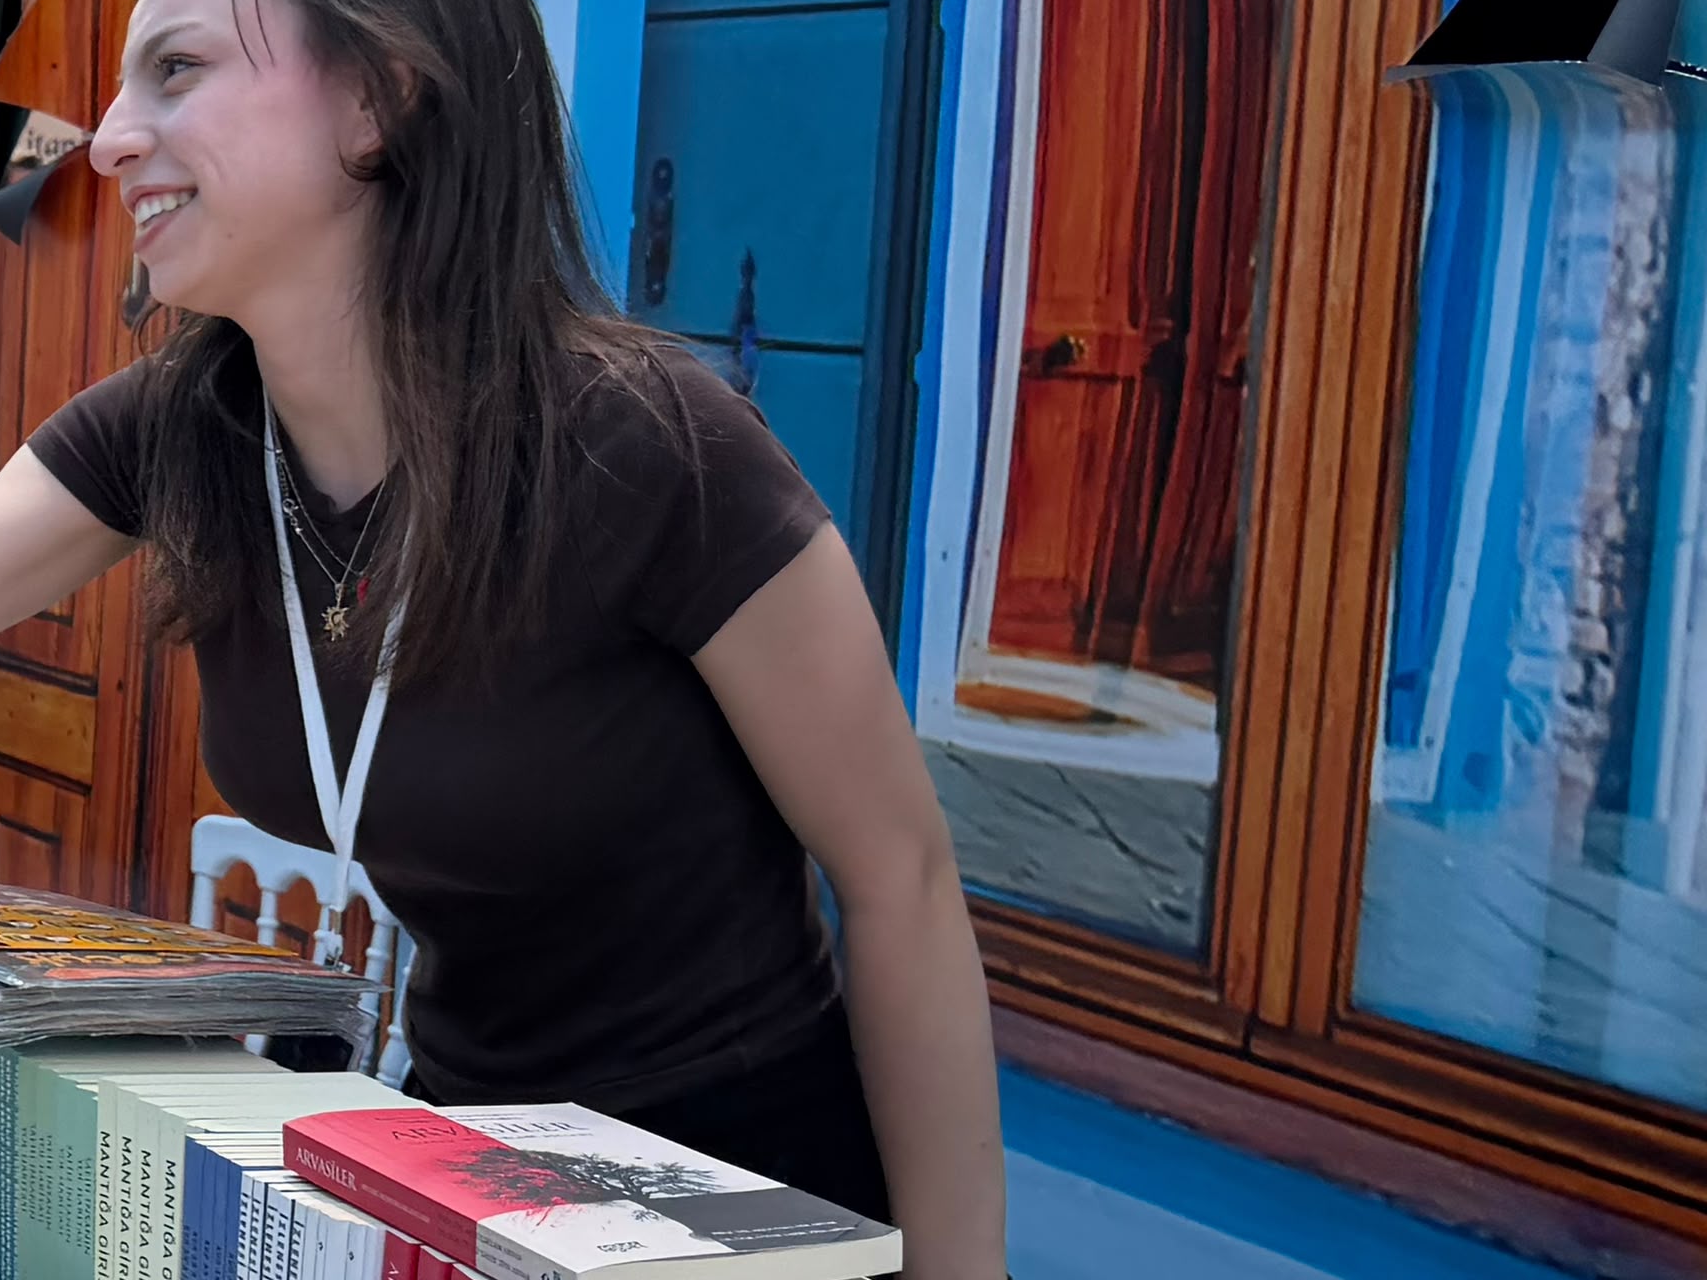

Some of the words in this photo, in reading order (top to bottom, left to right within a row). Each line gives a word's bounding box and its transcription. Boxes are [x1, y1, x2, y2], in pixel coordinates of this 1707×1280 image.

[99, 1130, 111, 1225] MANTIĞA
[120, 1136, 133, 1239] MANTIĞA
[139, 1149, 152, 1246] MANTIĞA
[162, 1159, 176, 1260] MANTIĞA
[295, 1147, 358, 1193] ARVASİLER
